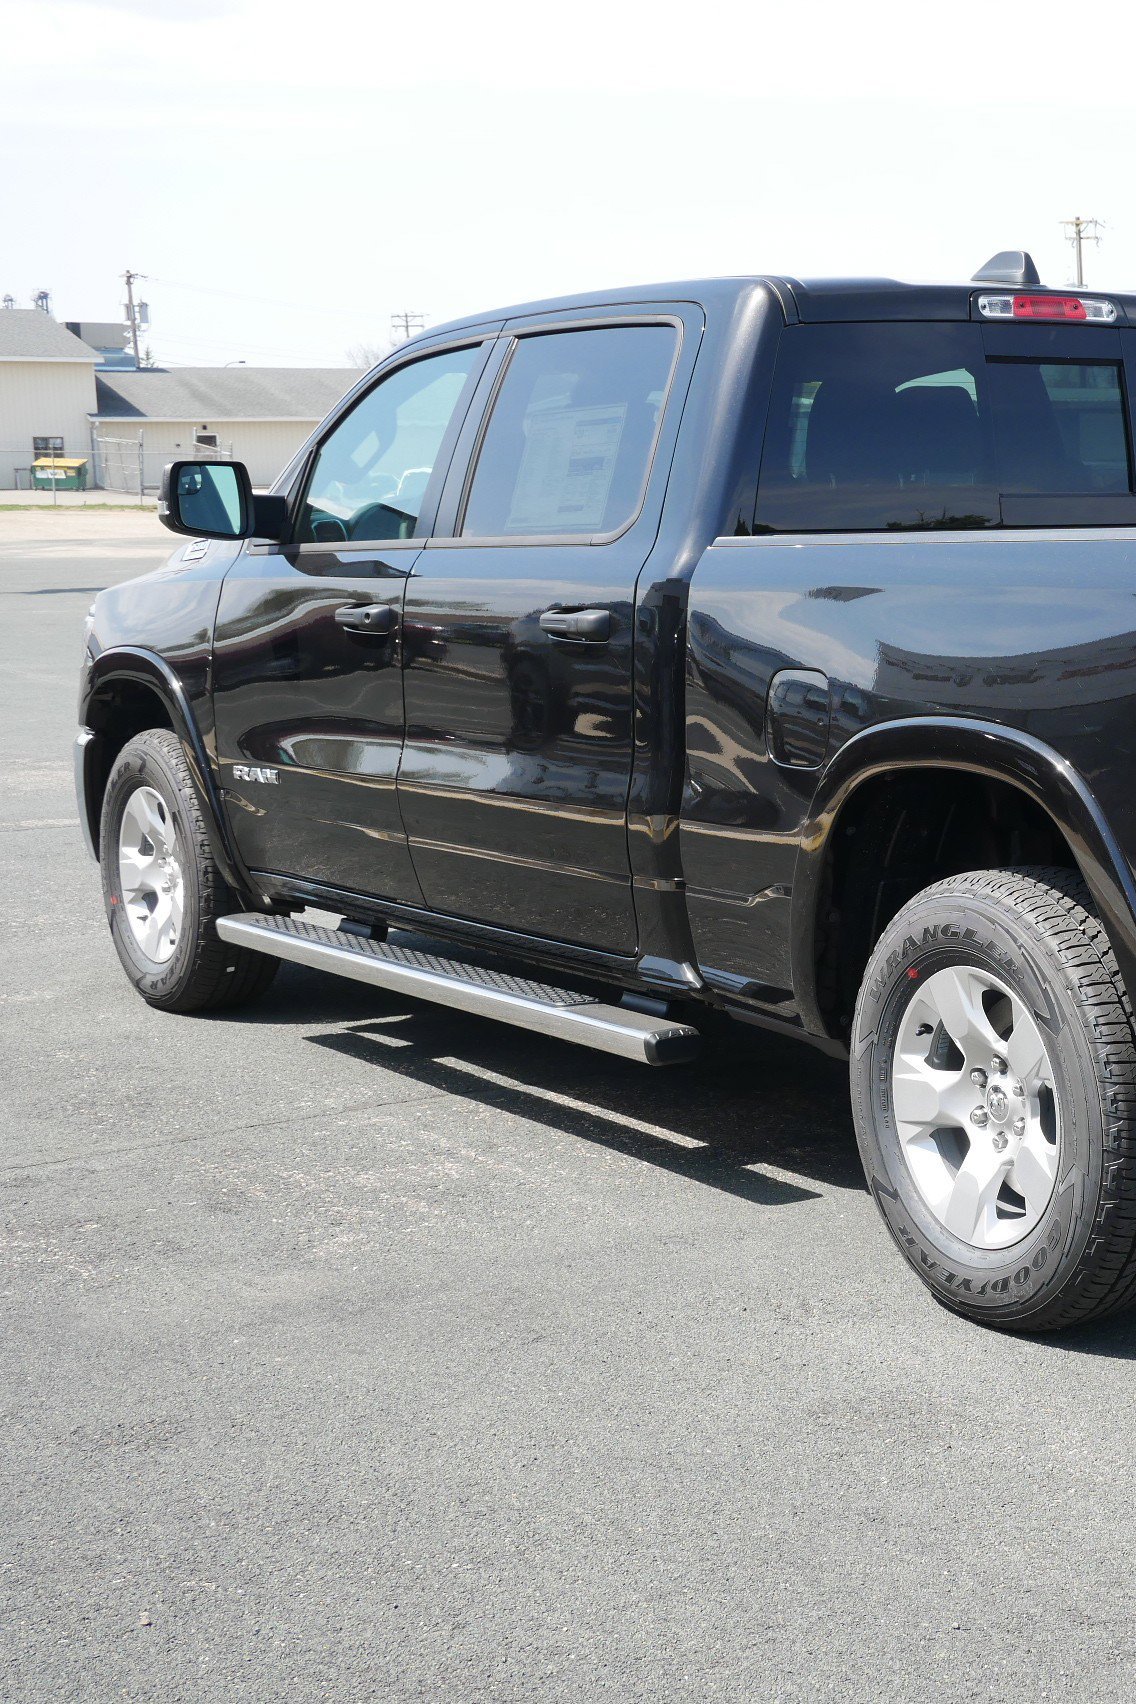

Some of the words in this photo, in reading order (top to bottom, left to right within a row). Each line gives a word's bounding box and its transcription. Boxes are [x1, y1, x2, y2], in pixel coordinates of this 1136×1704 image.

[233, 765, 280, 784] RAM
[869, 924, 1024, 1003] WRANGLER
[898, 1217, 1062, 1297] GOODYEAR
